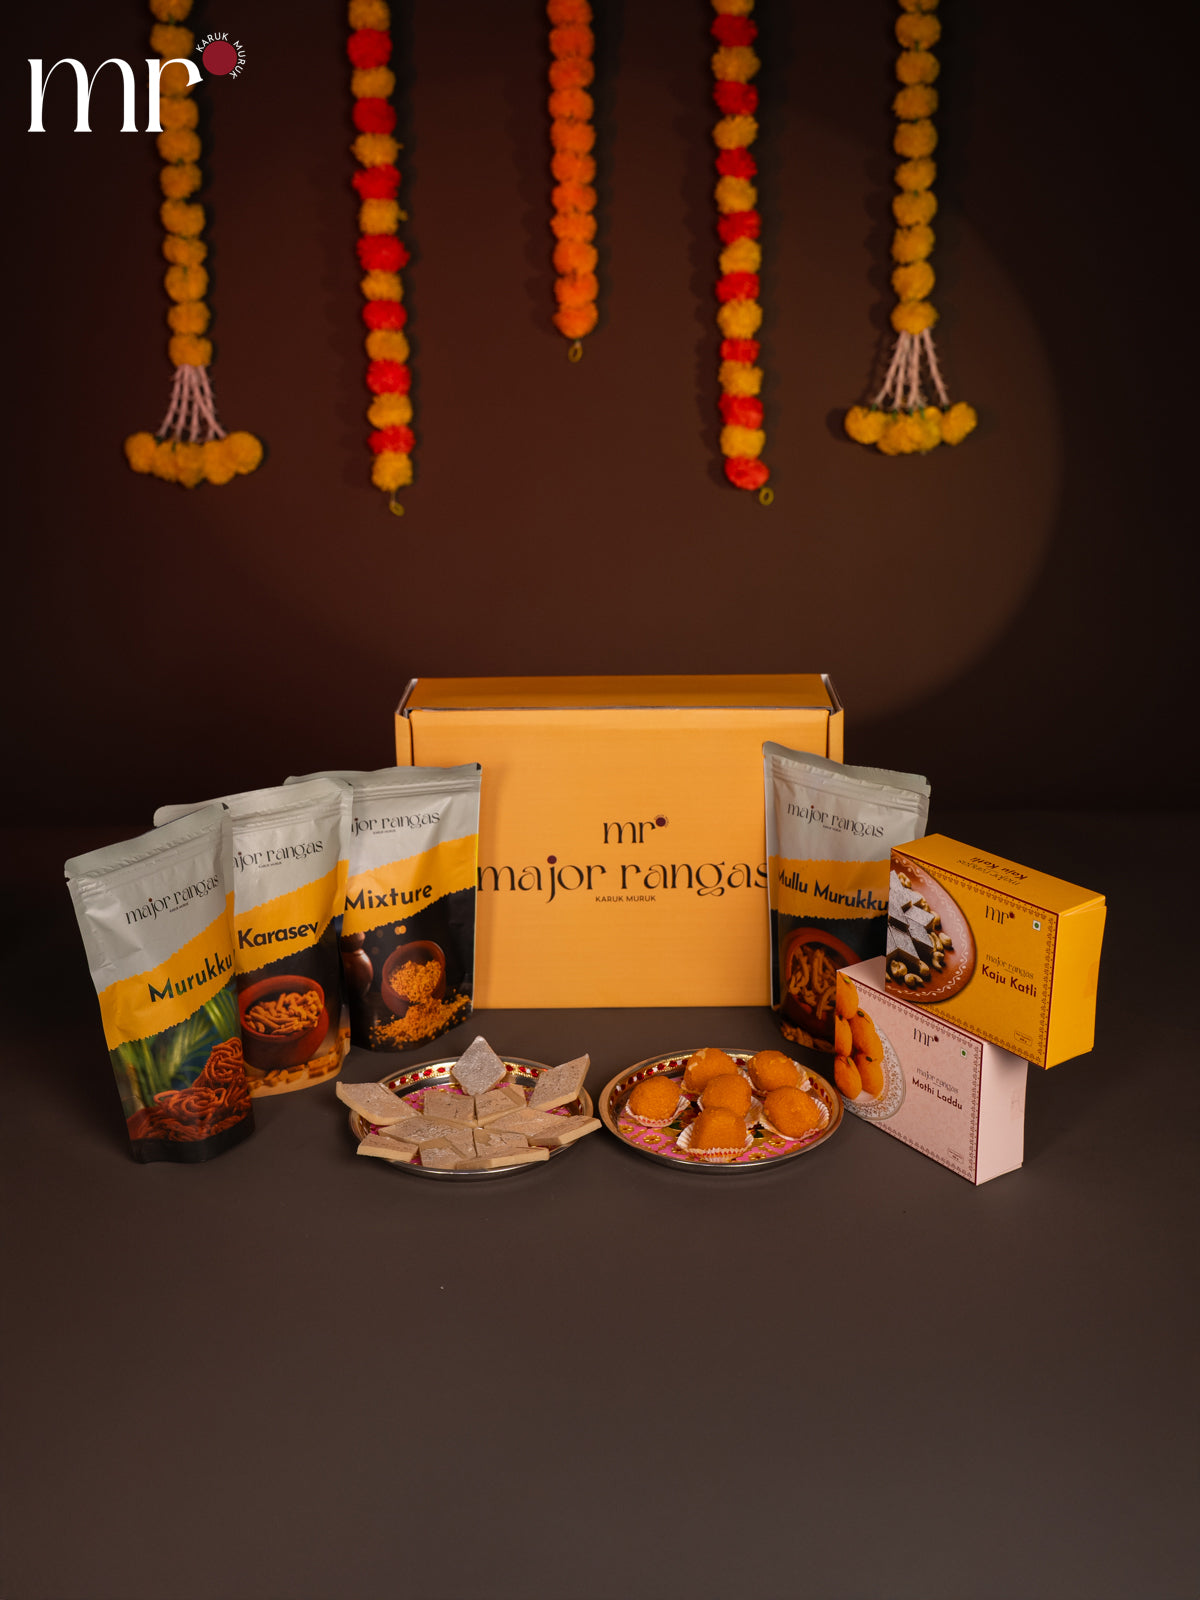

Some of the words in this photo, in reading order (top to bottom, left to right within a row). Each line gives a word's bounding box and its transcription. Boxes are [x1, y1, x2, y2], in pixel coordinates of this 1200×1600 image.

[351, 817, 378, 837] jor
[382, 812, 441, 830] rangas
[603, 820, 656, 844] mr
[787, 802, 829, 824] major
[831, 814, 884, 838] rangas
[266, 840, 324, 863] rangas
[477, 855, 607, 904] major
[620, 861, 768, 897] rangas
[344, 884, 433, 911] Mixture
[595, 895, 624, 903] KARUK
[814, 879, 889, 912] Murukku
[125, 897, 171, 925] major
[985, 905, 1010, 925] mr
[237, 921, 319, 950] Karasev
[147, 951, 233, 1003] Murukku
[982, 963, 1006, 985] Kaju
[1010, 976, 1037, 998] Katli
[913, 1027, 935, 1047] mr
[912, 1075, 935, 1095] Mothi
[937, 1089, 963, 1110] Laddu
